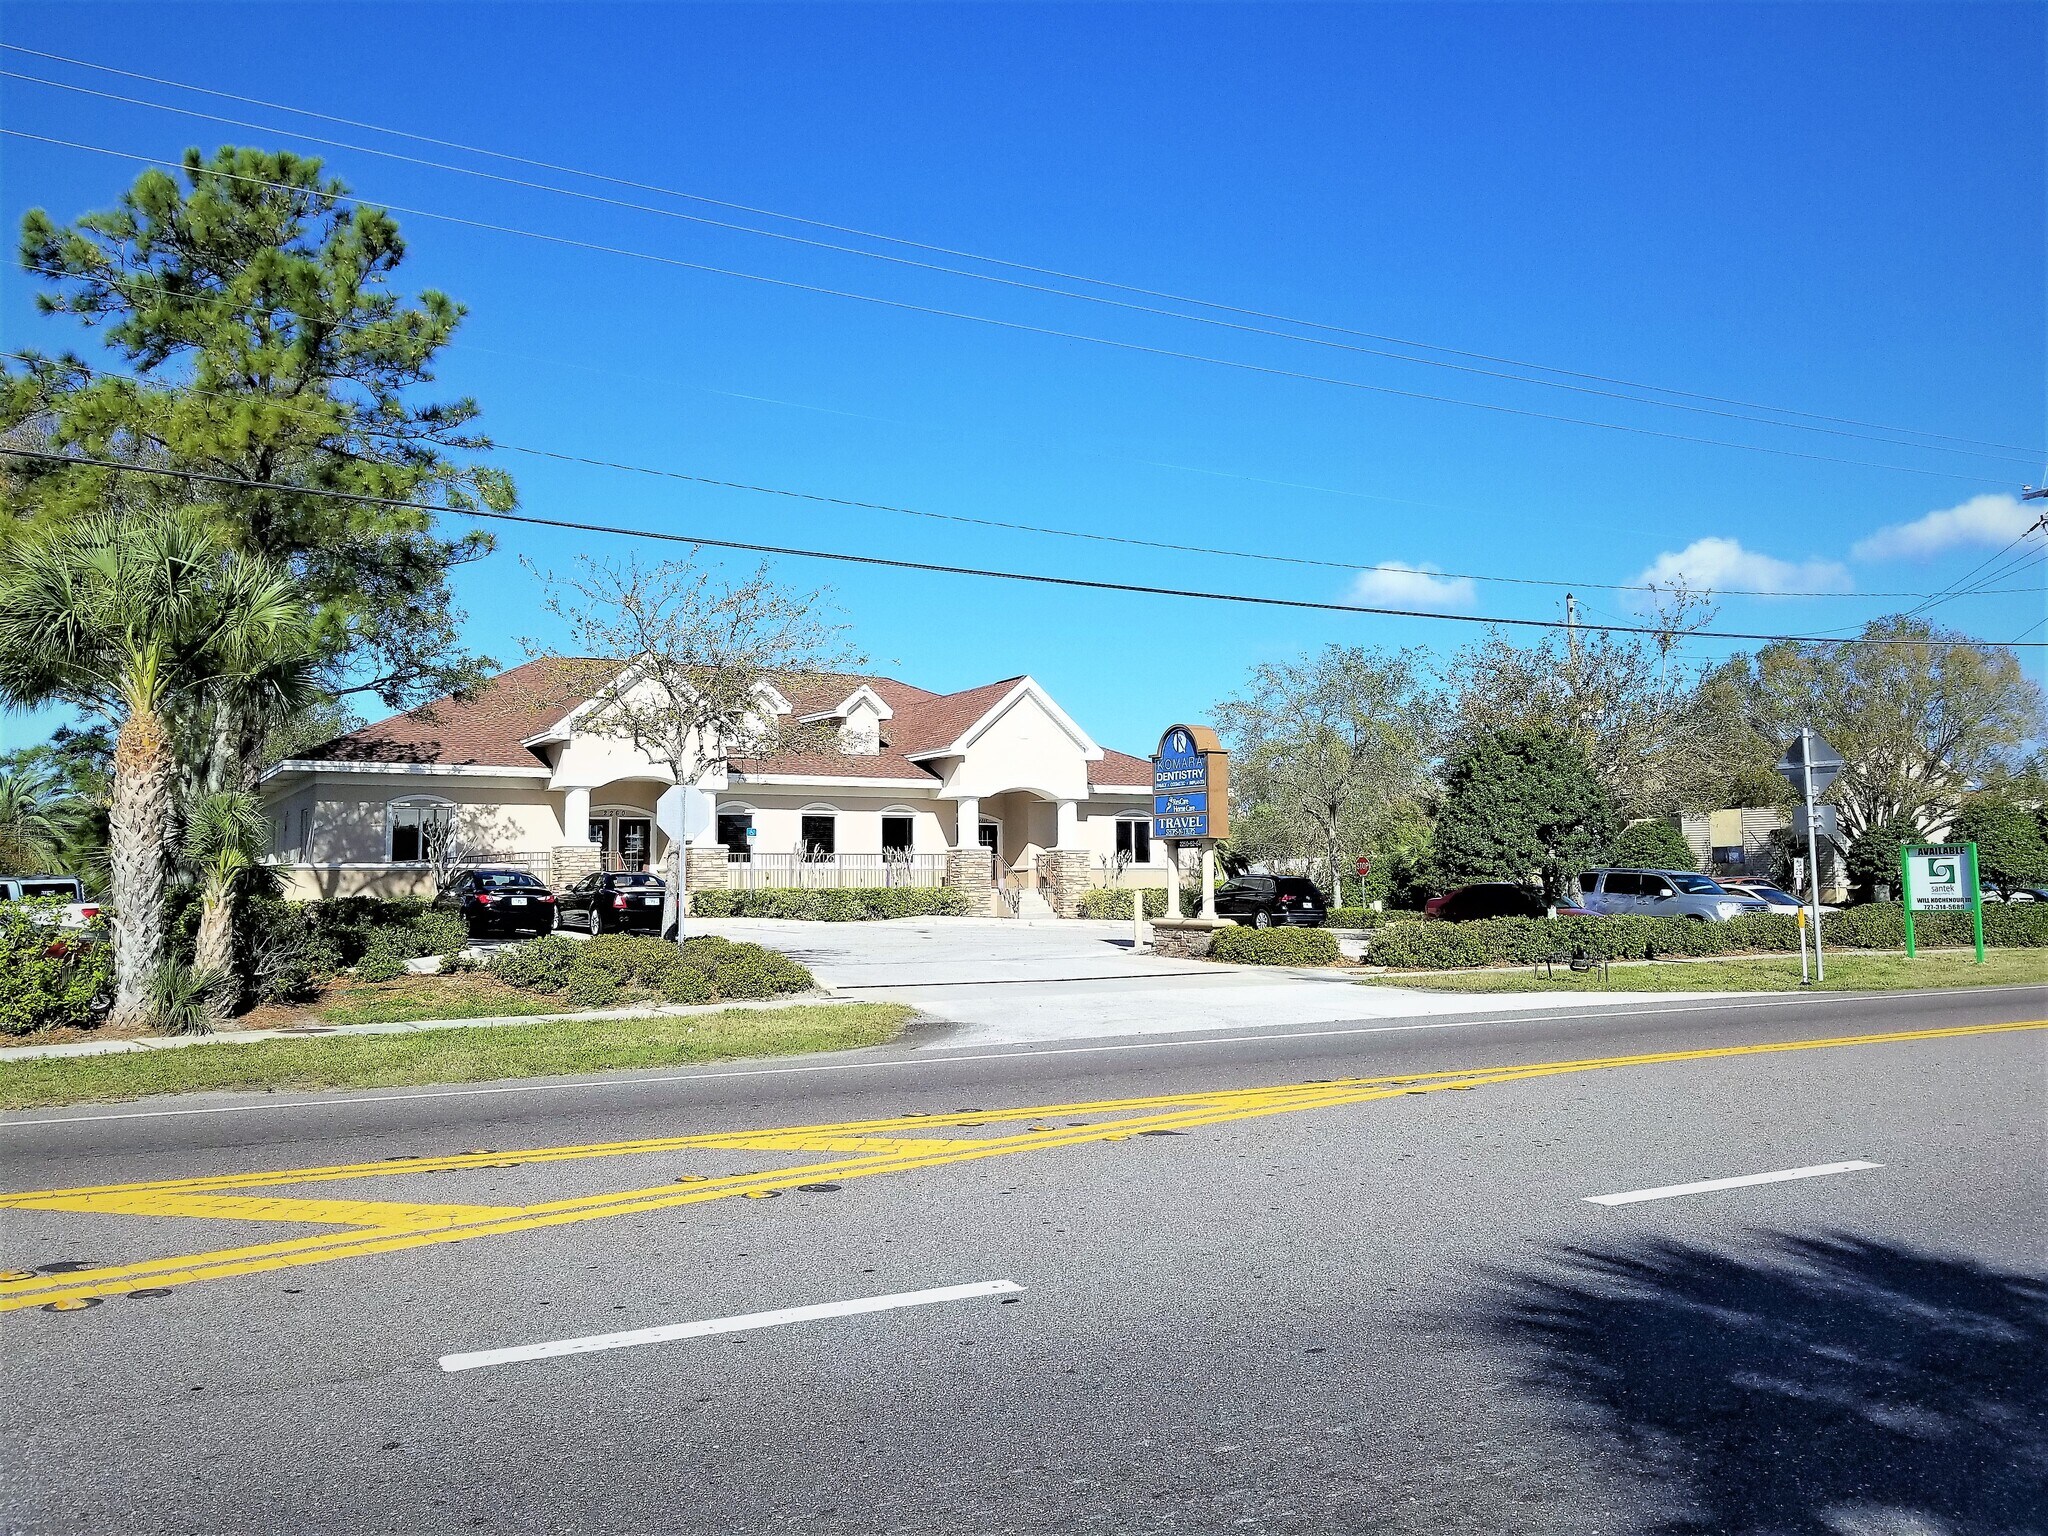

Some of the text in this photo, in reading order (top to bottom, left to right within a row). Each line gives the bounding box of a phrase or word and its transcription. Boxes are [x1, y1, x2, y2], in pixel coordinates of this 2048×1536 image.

[1157, 757, 1203, 770] KOMARA
[1156, 769, 1204, 782] DENTISTRY
[1158, 816, 1203, 829] TRAVEL
[1917, 846, 1965, 856] AVAILABLE
[1356, 862, 1369, 870] STOP
[1931, 884, 1955, 892] santek
